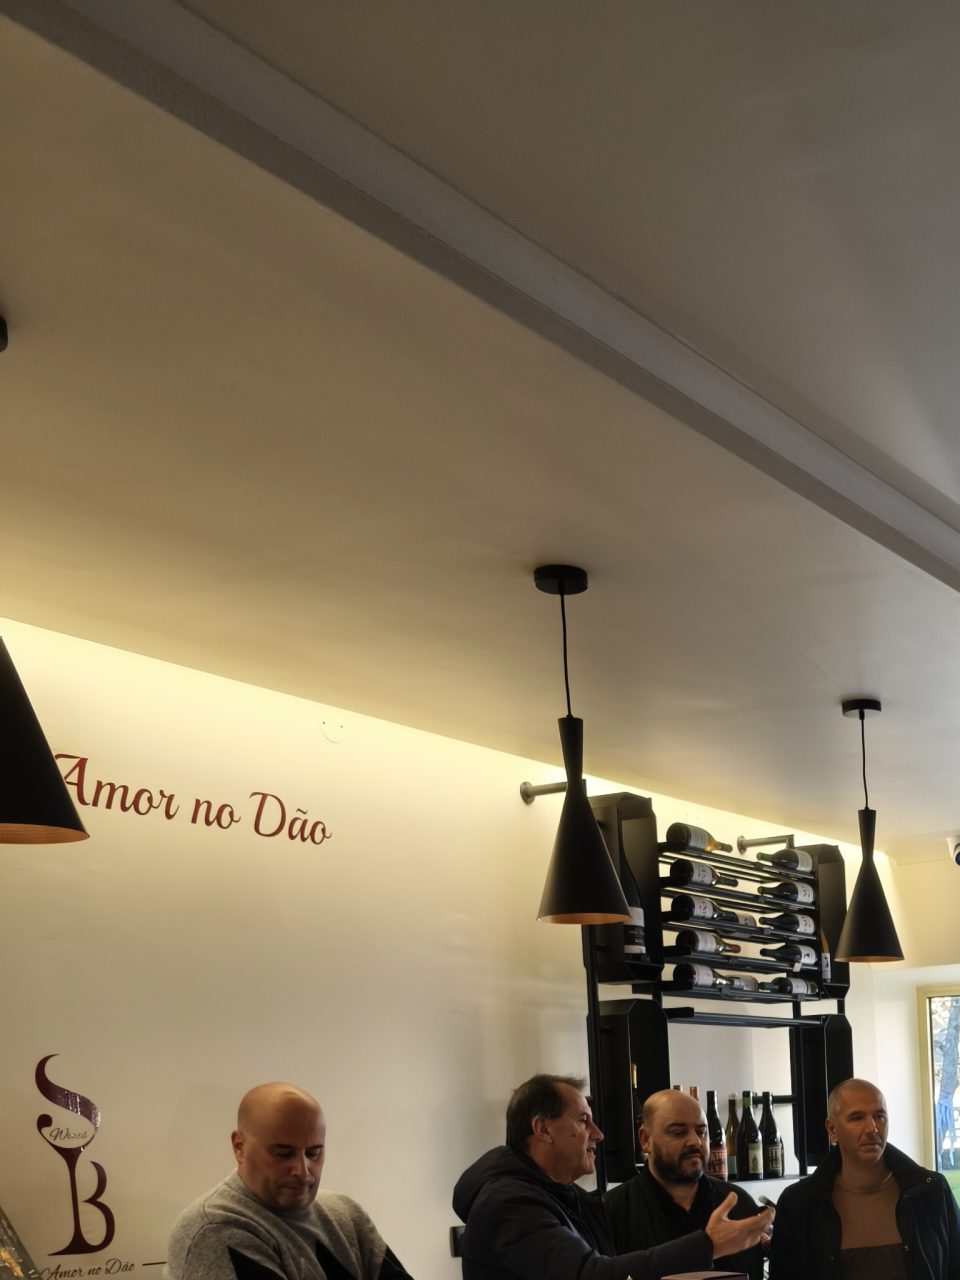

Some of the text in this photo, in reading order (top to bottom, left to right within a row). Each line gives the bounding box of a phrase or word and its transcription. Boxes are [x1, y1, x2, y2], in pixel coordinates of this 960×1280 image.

[54, 753, 332, 846] Amor no Dão
[40, 1258, 136, 1280] Amor no Dão
